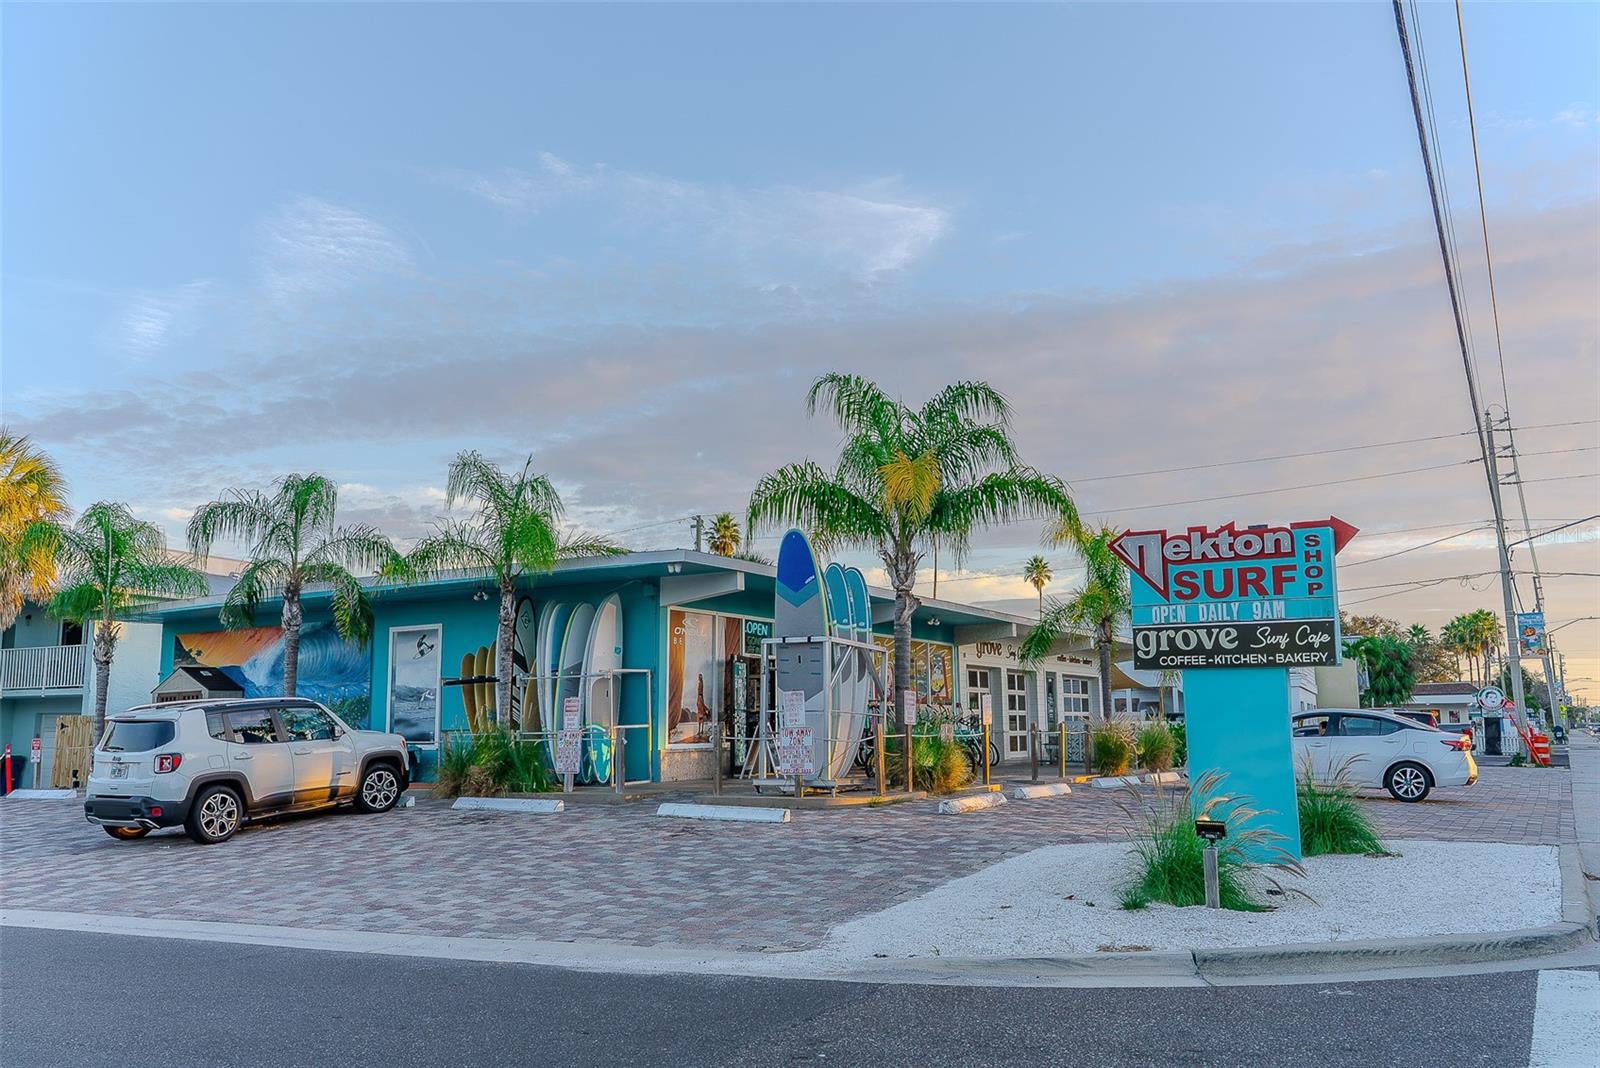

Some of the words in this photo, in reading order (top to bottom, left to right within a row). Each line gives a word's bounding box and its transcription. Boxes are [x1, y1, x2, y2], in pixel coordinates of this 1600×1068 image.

[1303, 534, 1323, 595] SHOP
[1173, 565, 1297, 600] SURF
[1152, 606, 1186, 624] OPEN
[1199, 603, 1239, 622] DAILY
[1253, 601, 1285, 620] 9AM
[746, 621, 769, 636] OPEN
[1136, 627, 1239, 660] grove
[1250, 626, 1290, 649] Surf
[1295, 624, 1331, 649] Cafe
[966, 641, 1003, 659] grove
